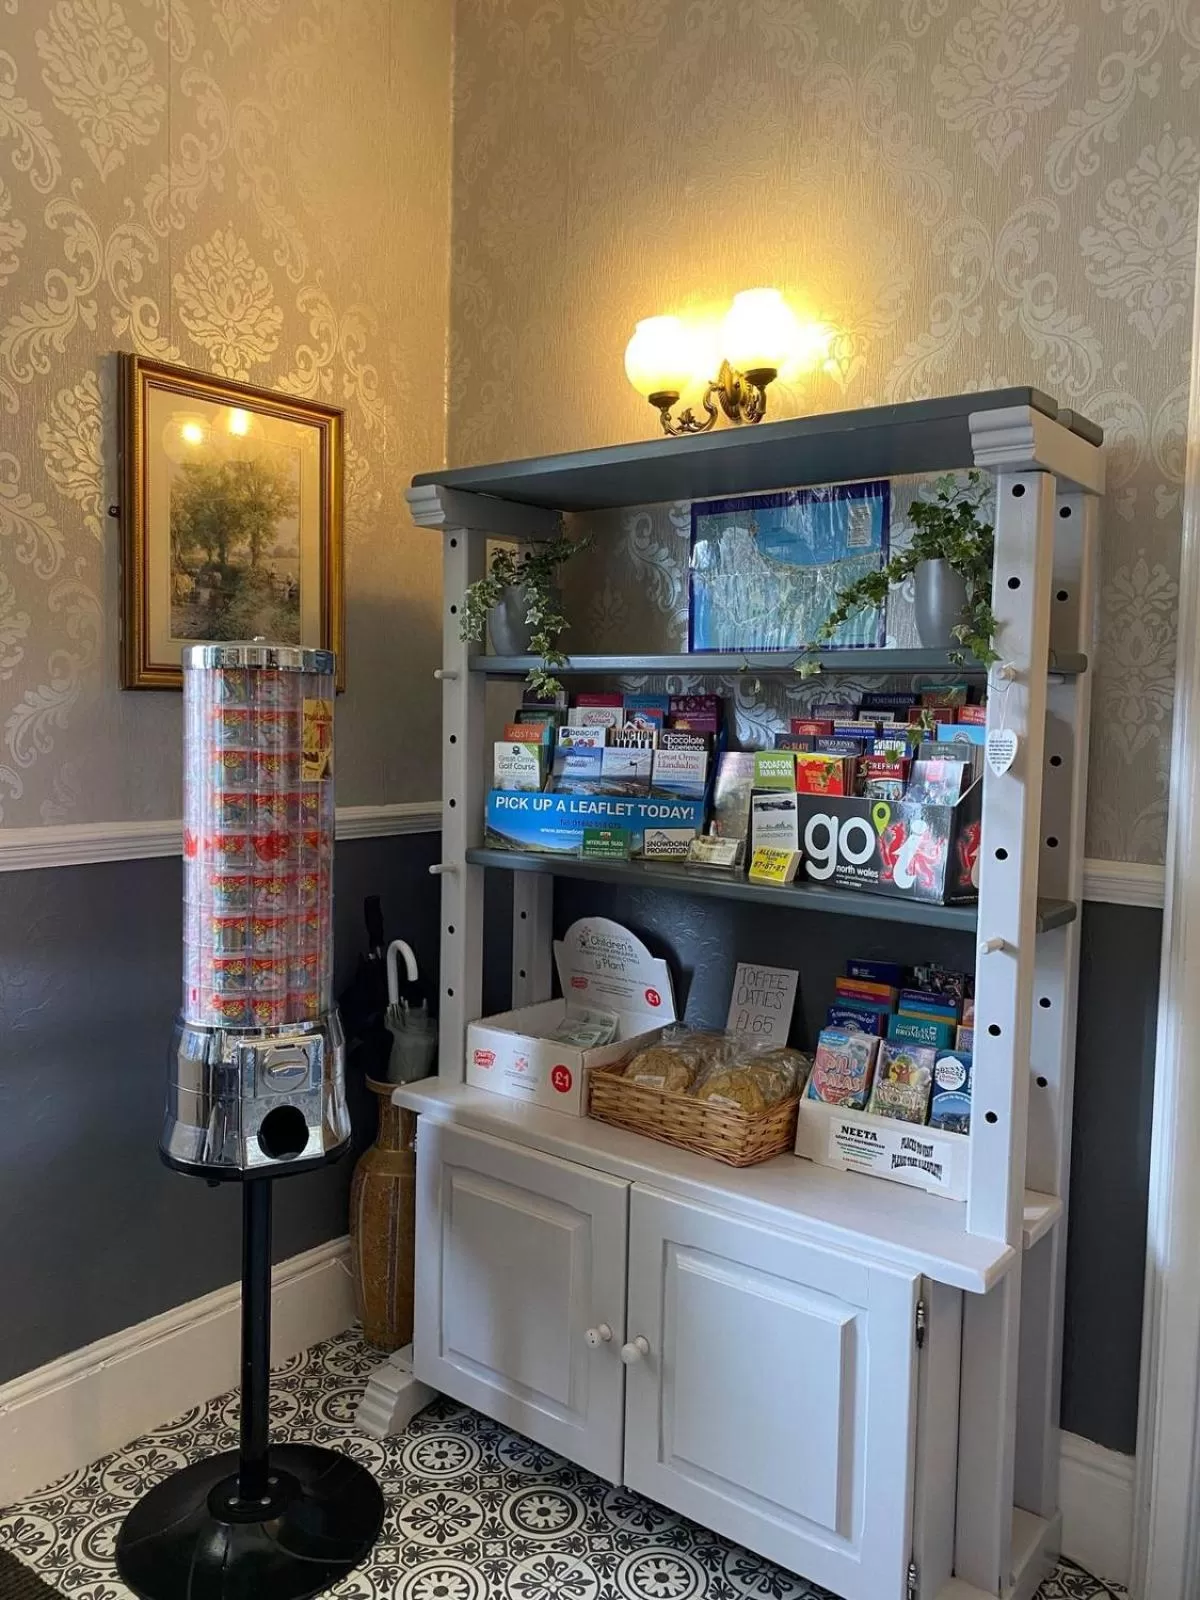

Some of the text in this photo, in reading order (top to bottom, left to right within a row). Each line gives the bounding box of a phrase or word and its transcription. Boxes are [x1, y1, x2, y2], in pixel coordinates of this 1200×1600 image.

[570, 729, 600, 737] beacon
[663, 733, 705, 745] Chocolate
[668, 743, 705, 751] Experience
[657, 752, 677, 761] Great
[498, 762, 512, 770] Golf
[495, 796, 695, 820] PICK UP A LEAFLET TODAY!
[646, 840, 690, 848] SNOWDONI
[804, 813, 876, 880] go
[836, 865, 879, 878] north wales
[590, 935, 634, 953] Children's
[738, 966, 790, 991] TOFFEE
[647, 992, 659, 1005] £1
[736, 985, 785, 1010] OATIES
[555, 1071, 569, 1088] £1
[840, 1125, 879, 1142] NEETA
[900, 1137, 917, 1154] PLACES
[922, 1143, 934, 1158] VISIT
[891, 1154, 908, 1170] PLEASE
